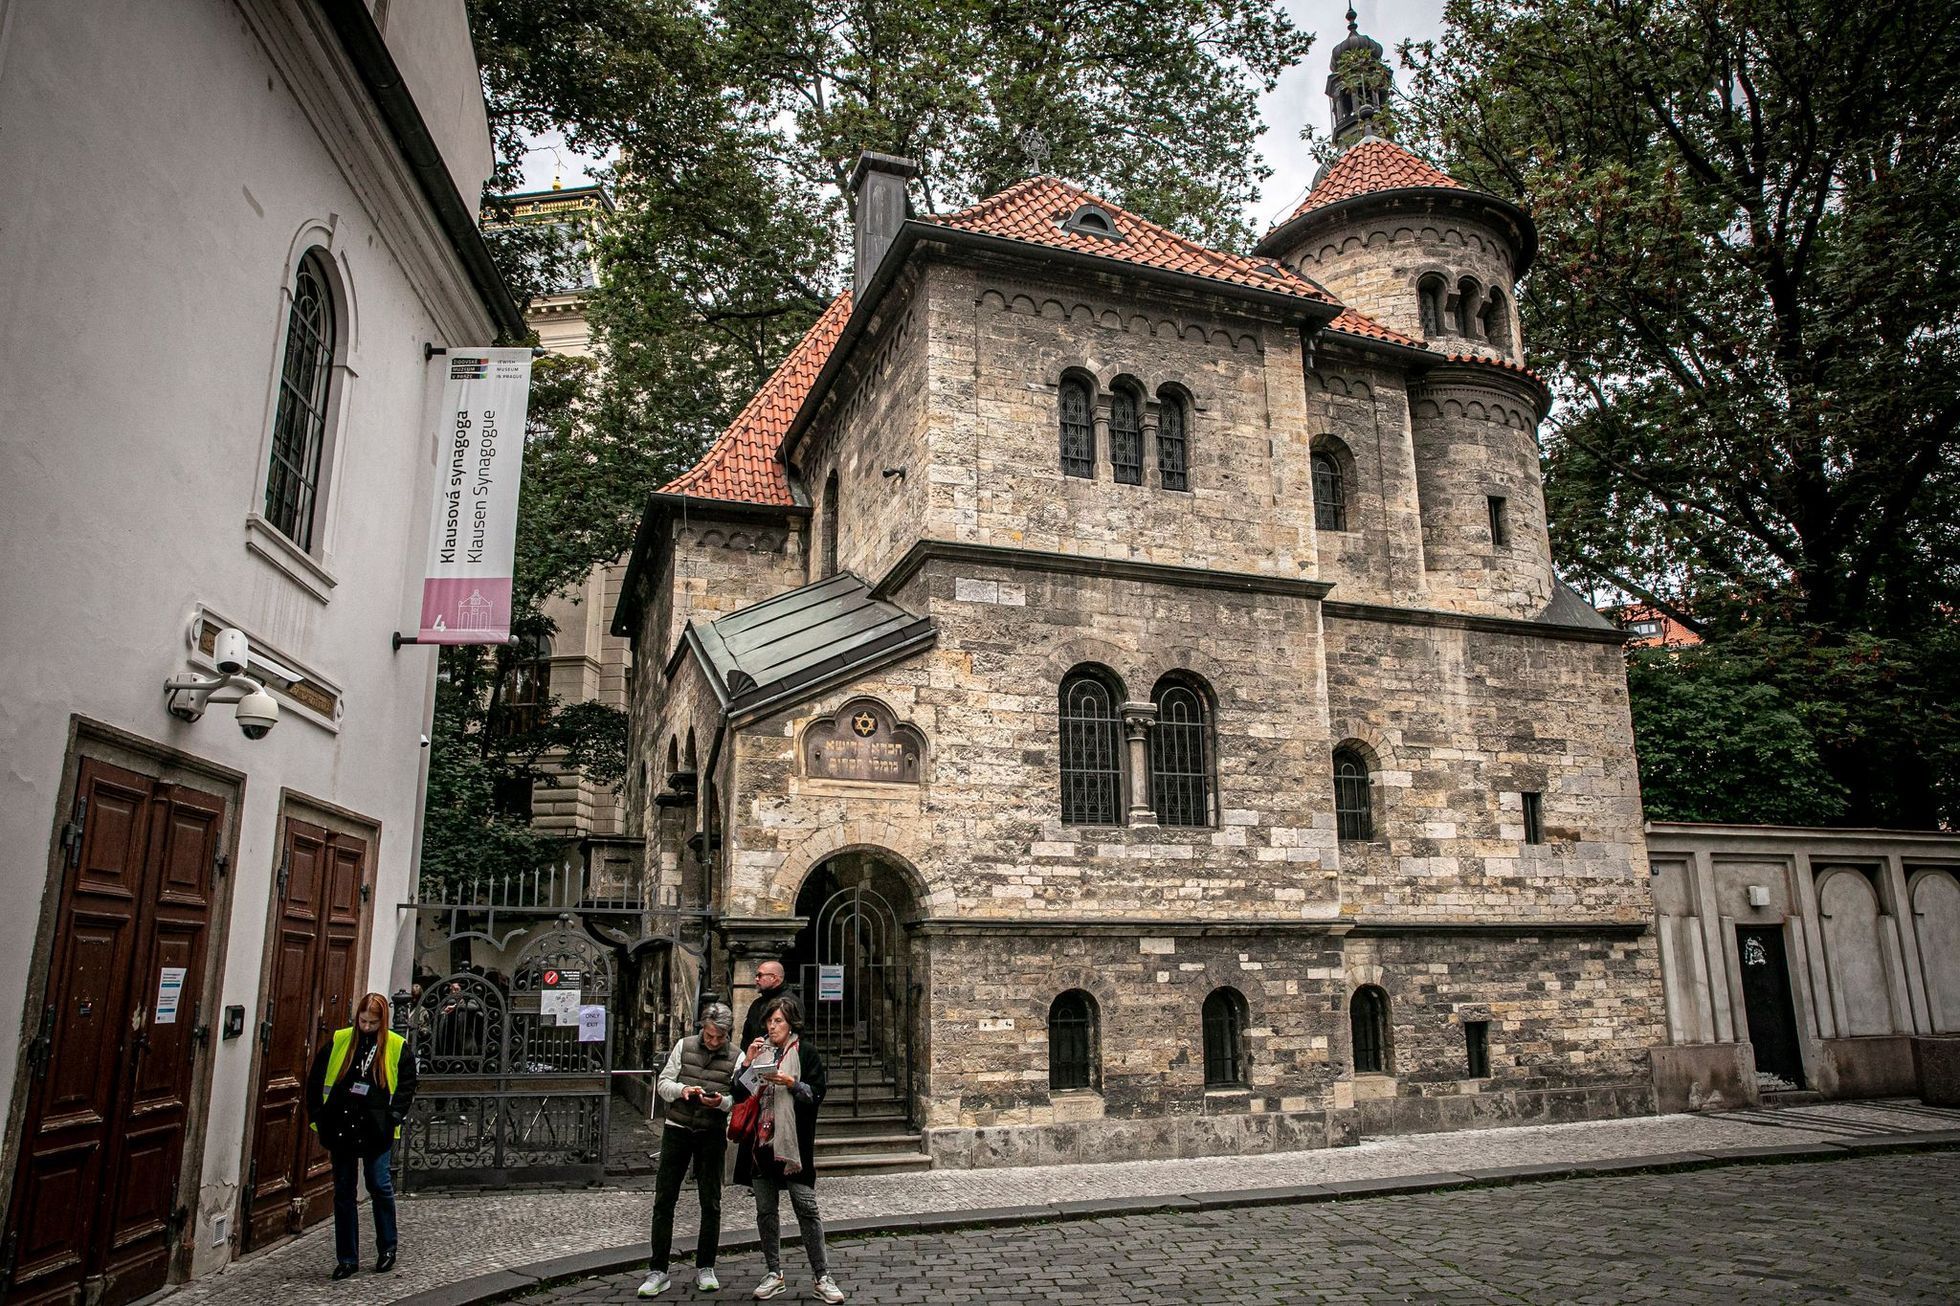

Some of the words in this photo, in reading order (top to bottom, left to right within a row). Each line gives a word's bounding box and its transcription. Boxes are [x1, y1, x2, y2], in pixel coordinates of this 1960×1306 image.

[440, 490, 461, 563] Klausová
[451, 410, 471, 486] synagoga
[473, 410, 497, 496] Synagogue
[467, 500, 487, 563] Klausen
[432, 614, 447, 633] 4
